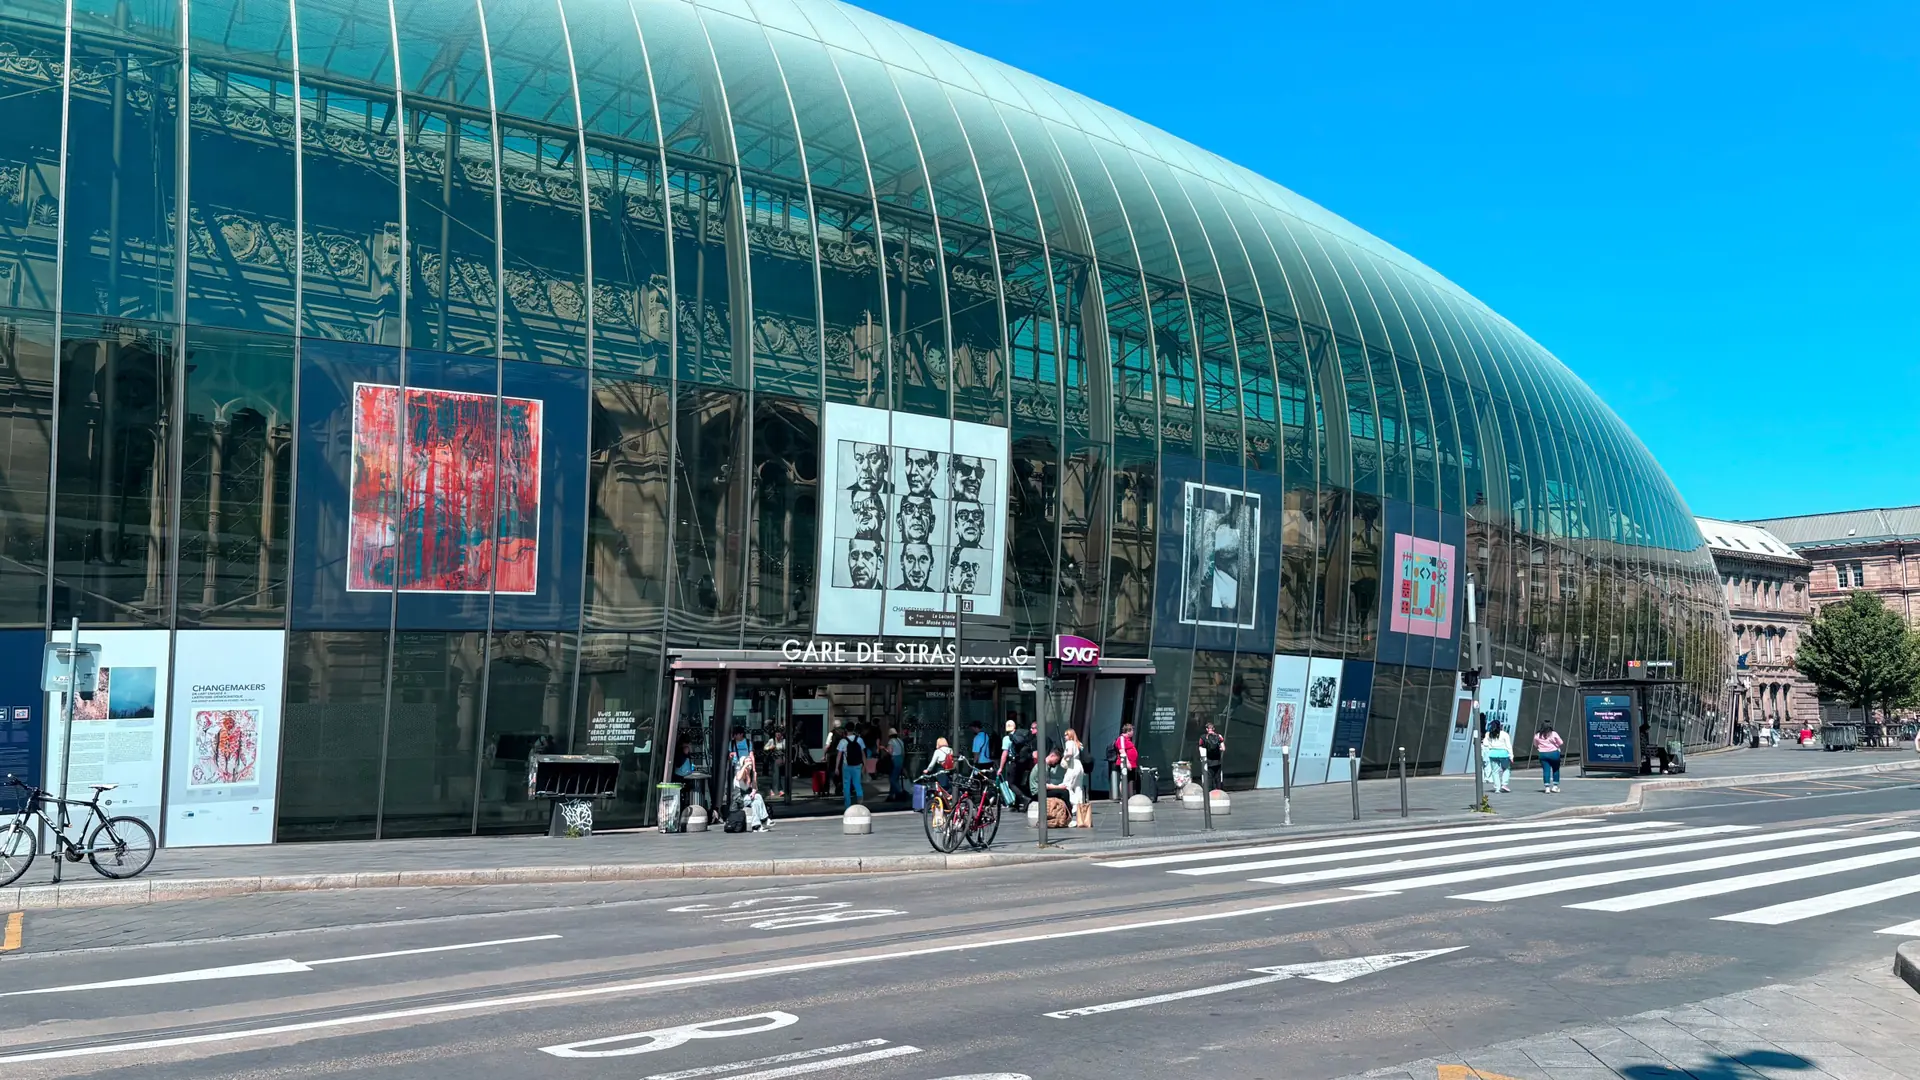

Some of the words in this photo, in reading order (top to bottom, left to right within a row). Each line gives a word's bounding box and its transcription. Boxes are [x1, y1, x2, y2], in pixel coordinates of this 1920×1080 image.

[782, 639, 846, 663] GARE
[857, 641, 884, 663] DE
[1061, 646, 1099, 662] SNCF
[192, 684, 266, 692] CHANGEMAKERS
